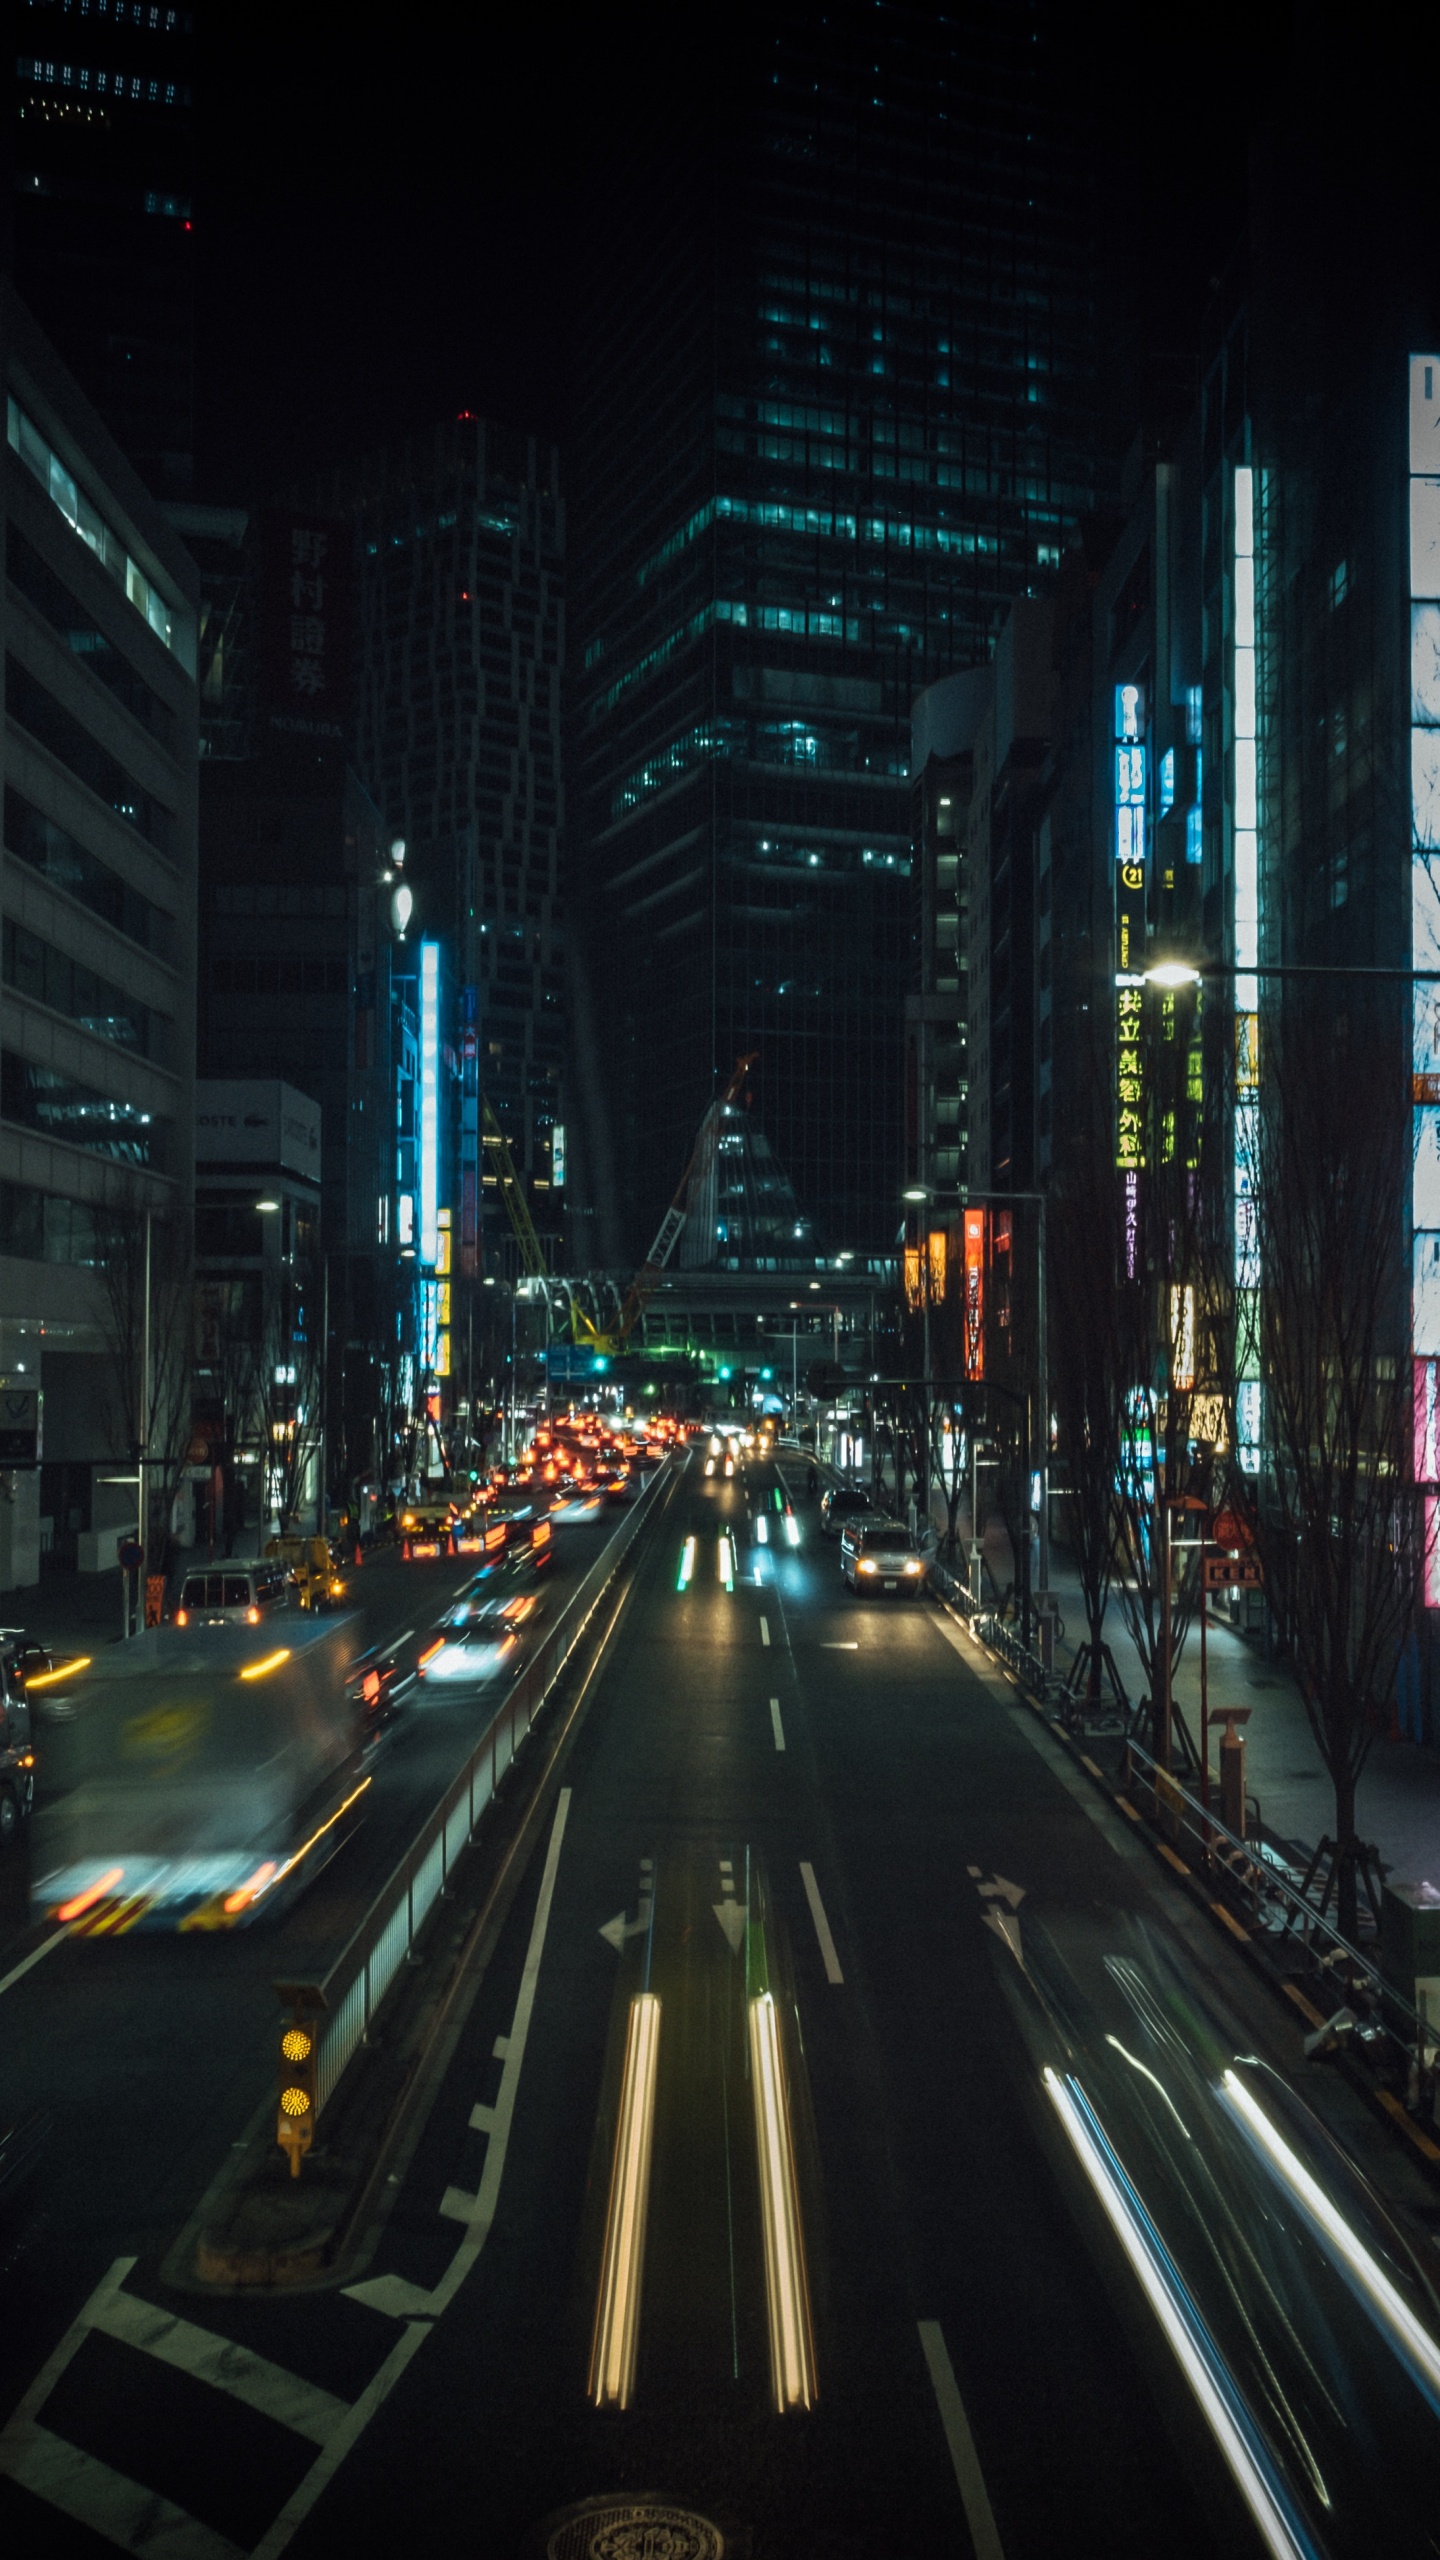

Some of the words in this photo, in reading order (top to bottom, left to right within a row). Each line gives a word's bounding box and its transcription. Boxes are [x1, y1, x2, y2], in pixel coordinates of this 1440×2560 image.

[290, 527, 328, 696] 野村證券
[269, 714, 343, 738] NOMURA
[1130, 867, 1143, 883] 21
[1121, 927, 1129, 969] CENTURY
[197, 1115, 237, 1127] OSTE
